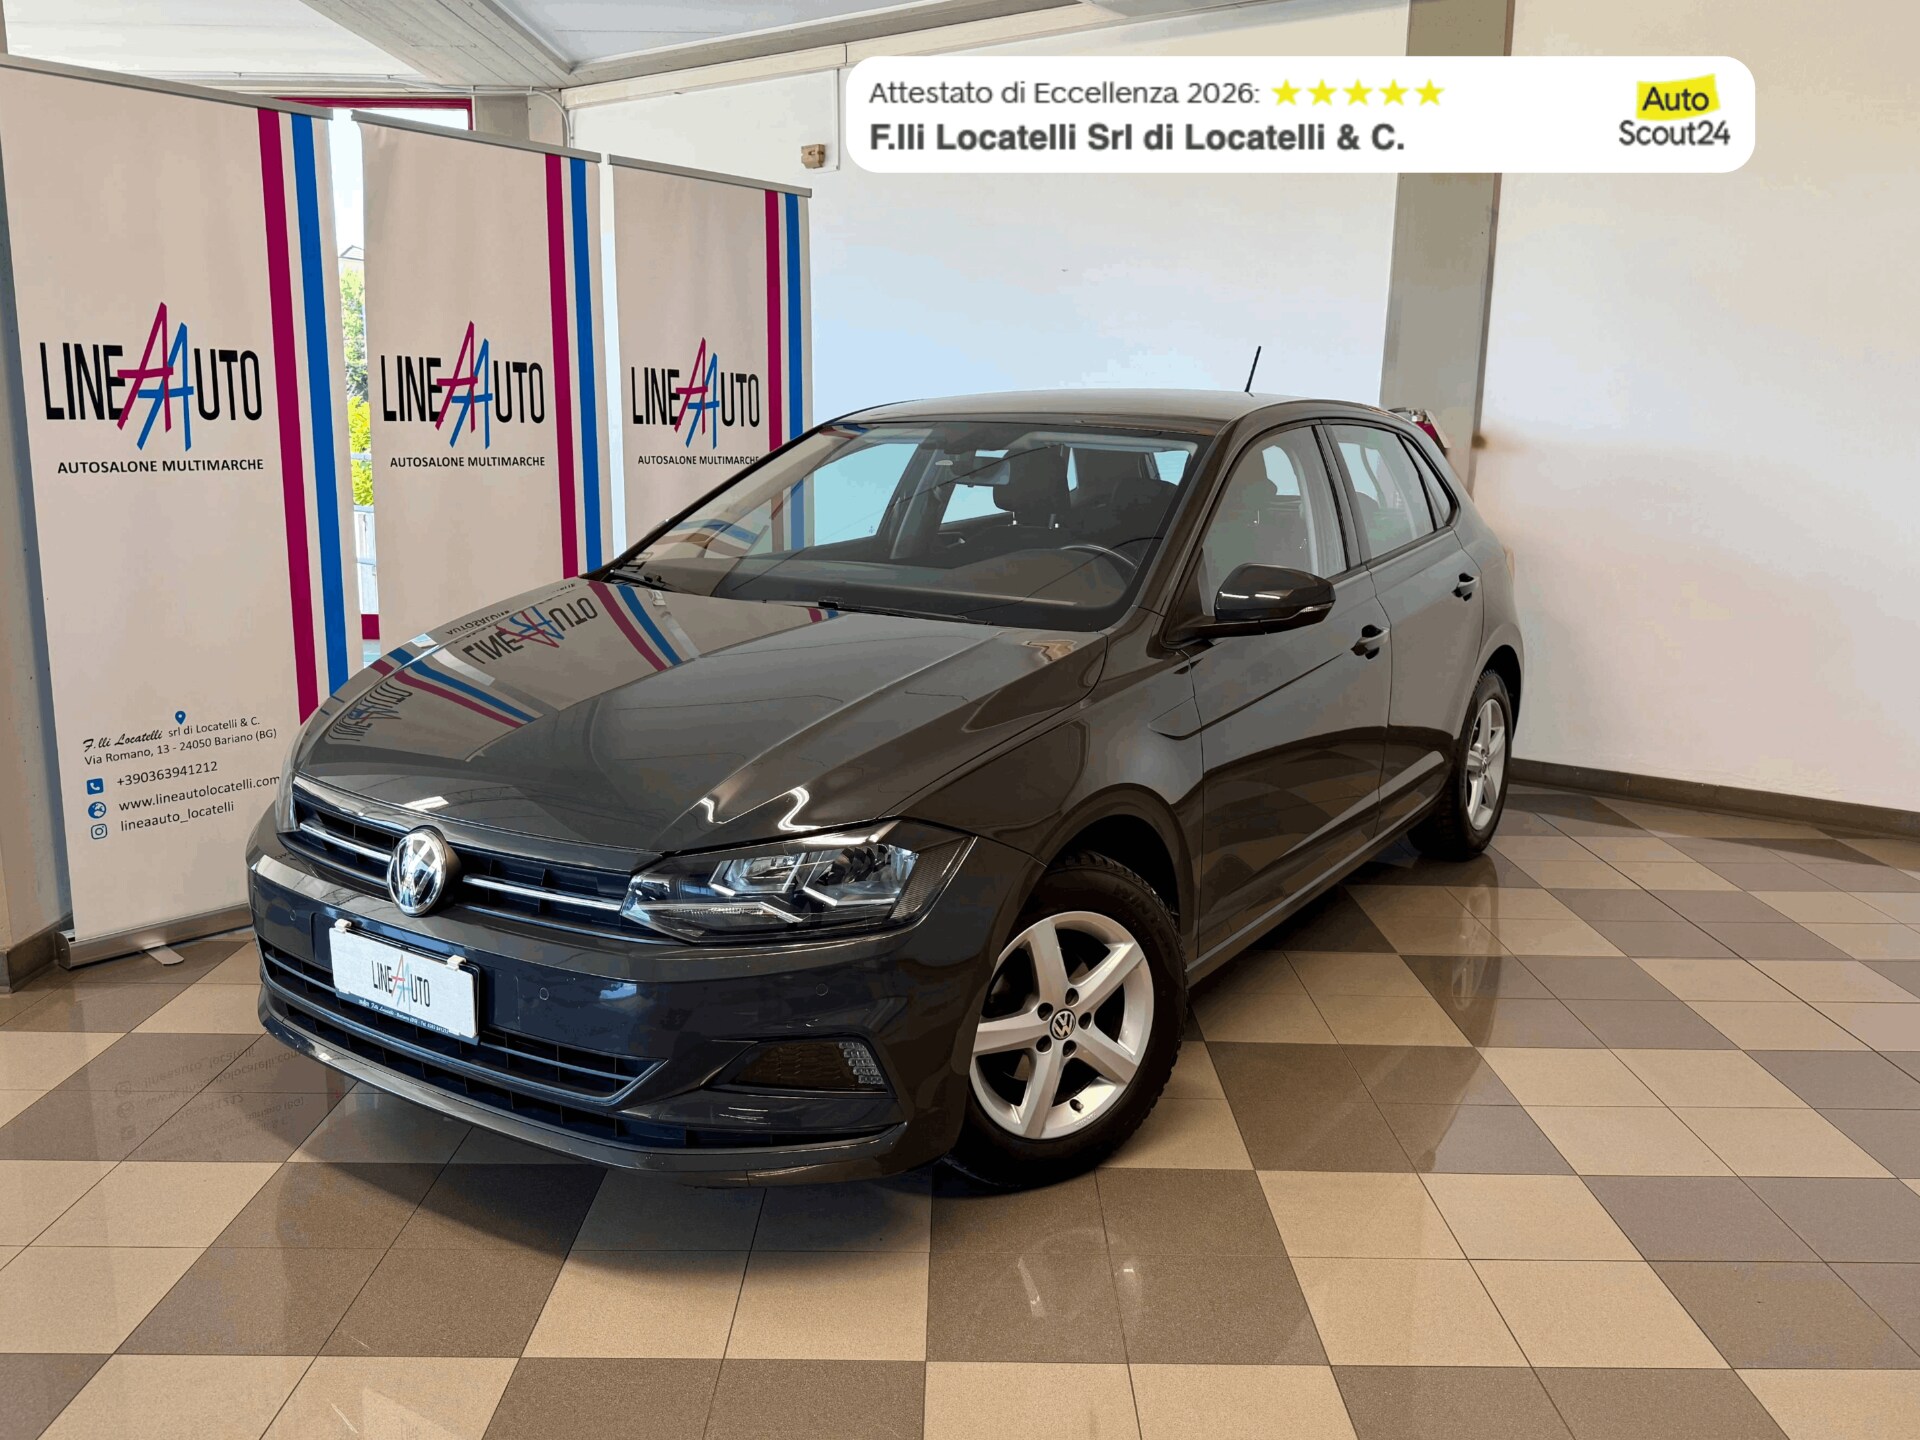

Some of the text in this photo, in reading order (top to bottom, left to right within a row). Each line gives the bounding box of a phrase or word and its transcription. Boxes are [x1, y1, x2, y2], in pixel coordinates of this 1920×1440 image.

[57, 458, 264, 474] AUTOSALONE MULTIMARCHE
[389, 456, 546, 469] AUTOSALONE MULTIMARCHE
[637, 456, 696, 466] AUTOSALONE
[113, 729, 163, 747] Locatelli
[168, 726, 182, 738] srl
[183, 725, 193, 735] di
[195, 718, 238, 734] Locatelli
[239, 717, 249, 728] &
[250, 716, 261, 726] C.
[84, 754, 103, 766] Via
[105, 748, 154, 763] Romano,
[156, 744, 170, 755] 13
[179, 738, 212, 751] 24050
[214, 733, 253, 746] Bariano
[255, 728, 277, 742] (BG)
[117, 761, 218, 786] +390363941212
[120, 801, 235, 832] lineaauto_locatelli
